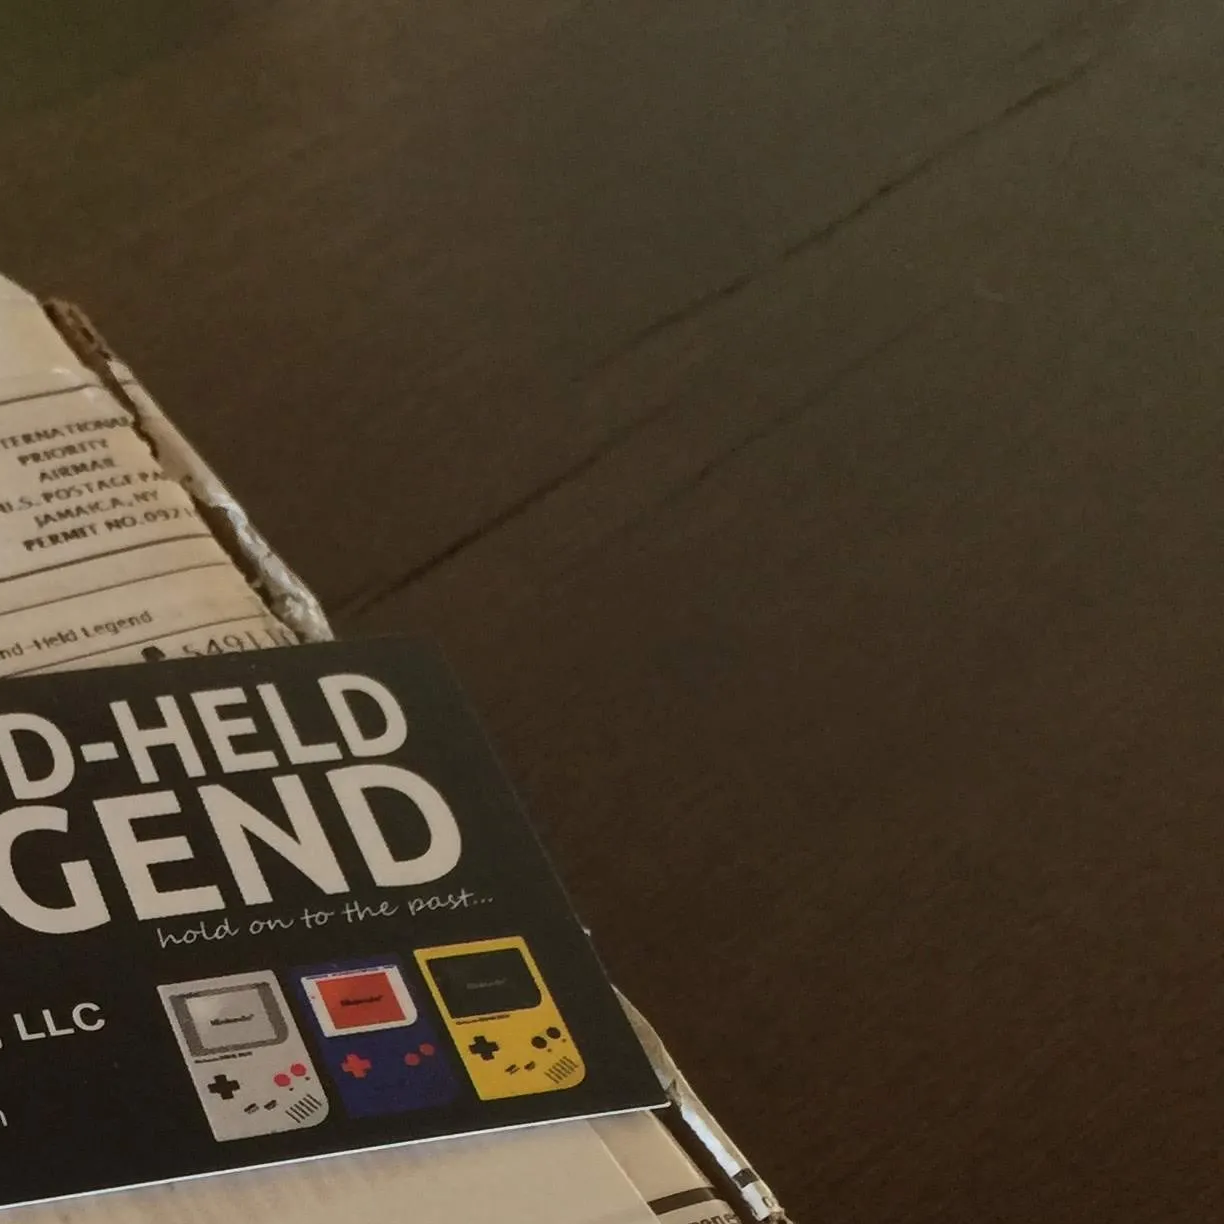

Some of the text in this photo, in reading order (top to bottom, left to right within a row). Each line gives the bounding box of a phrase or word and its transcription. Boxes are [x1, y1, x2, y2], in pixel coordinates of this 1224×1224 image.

[17, 438, 109, 467] PRIORITY
[23, 523, 98, 552] PERMIT
[81, 610, 154, 638] Legend
[156, 918, 239, 949] hold
[248, 917, 296, 936] on
[300, 907, 334, 930] to
[340, 899, 402, 924] the
[11, 1002, 107, 1042] LLC
